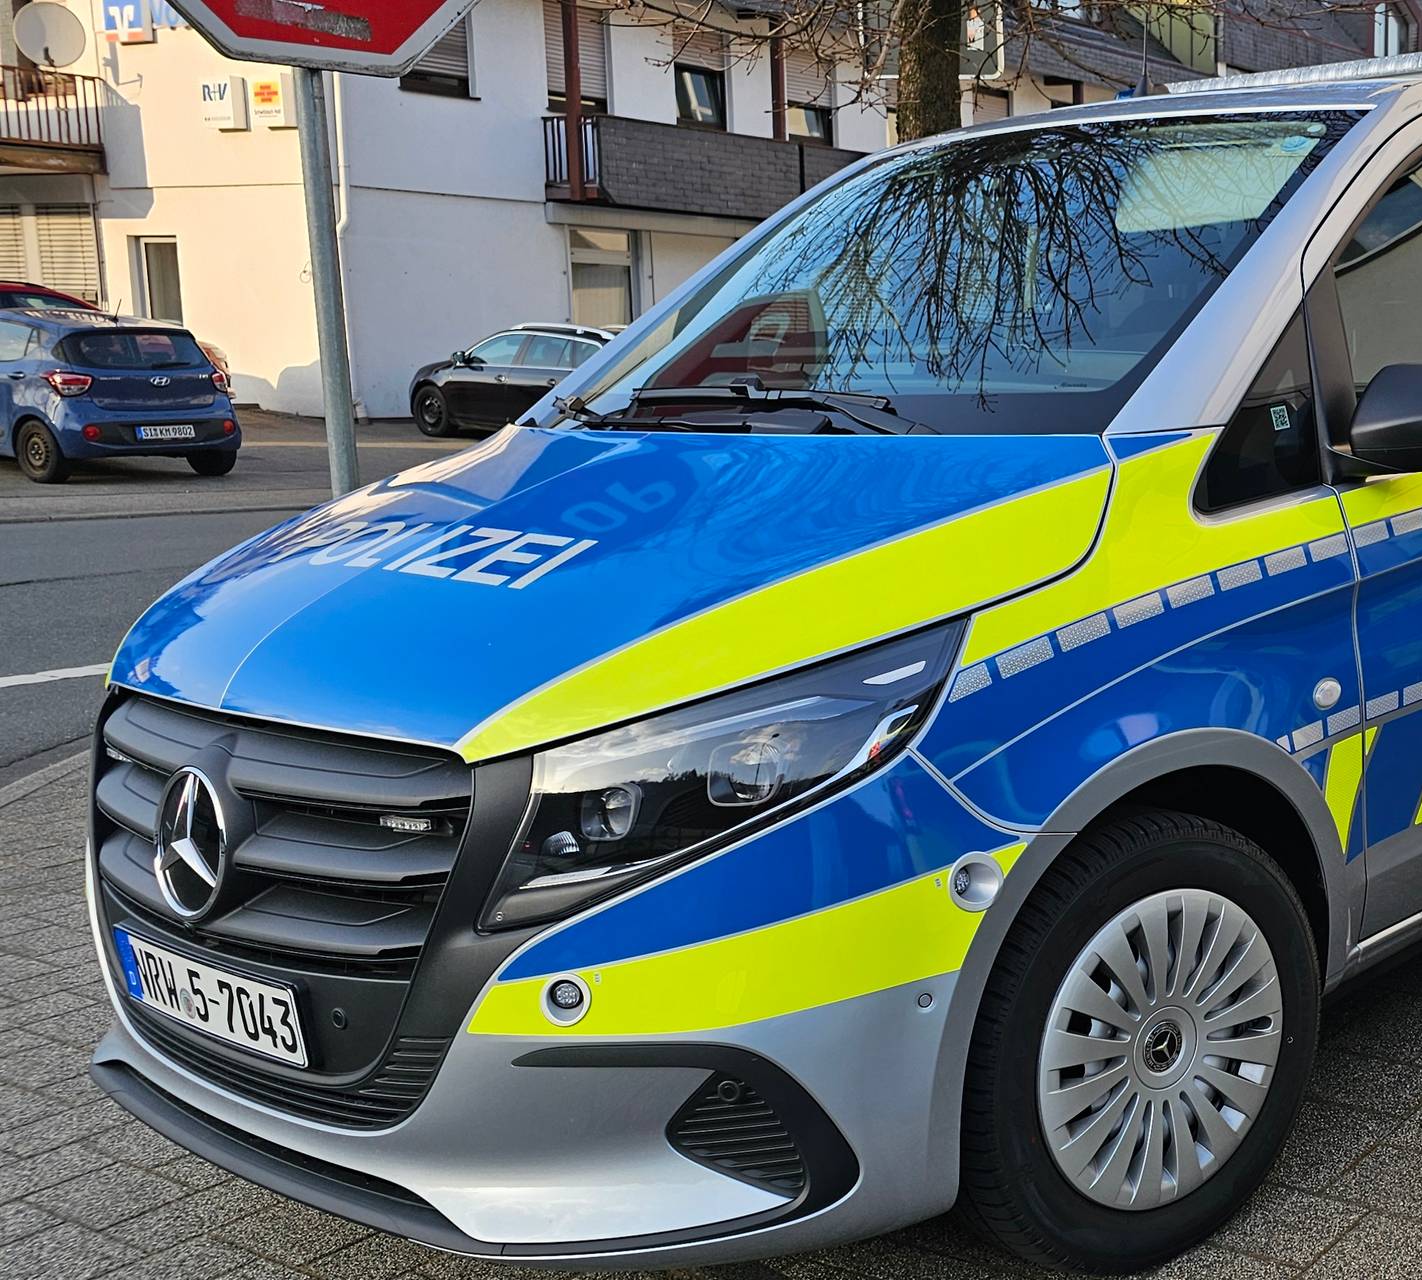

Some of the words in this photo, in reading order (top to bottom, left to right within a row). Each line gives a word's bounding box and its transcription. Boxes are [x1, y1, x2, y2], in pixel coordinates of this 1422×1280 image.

[202, 83, 228, 102] R+V
[268, 521, 599, 590] POLIZEI
[130, 944, 181, 1012] NRW
[186, 968, 298, 1054] 5-7043
